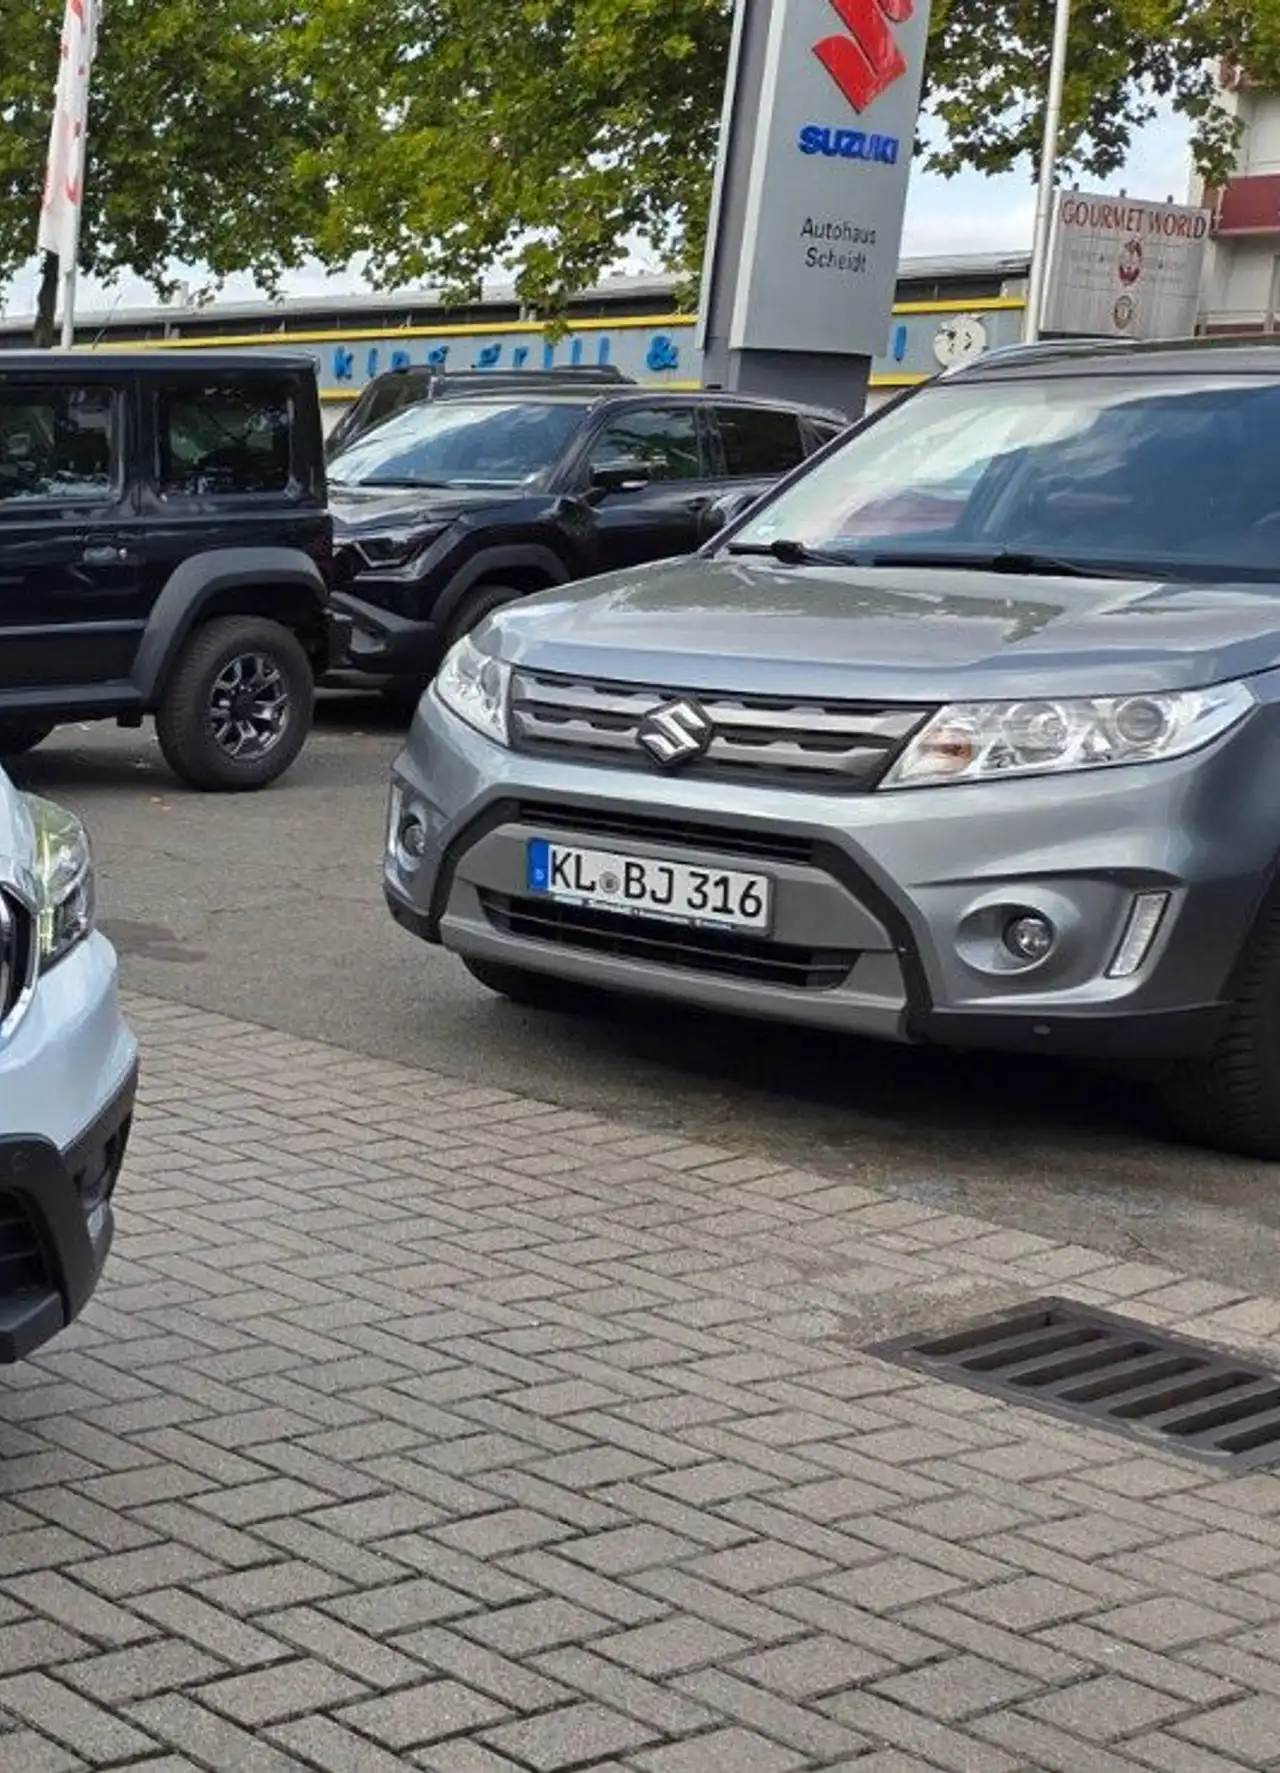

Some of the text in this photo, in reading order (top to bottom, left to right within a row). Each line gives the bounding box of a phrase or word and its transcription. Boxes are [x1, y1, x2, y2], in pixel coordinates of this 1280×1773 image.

[798, 124, 899, 165] SUZUKI
[800, 216, 876, 246] Autohaus
[1062, 199, 1207, 239] GOURMET WORLD
[805, 247, 867, 273] Scheidt
[646, 335, 680, 372] &
[551, 850, 596, 892] KL
[624, 861, 674, 906] BJ
[687, 871, 762, 918] 316
